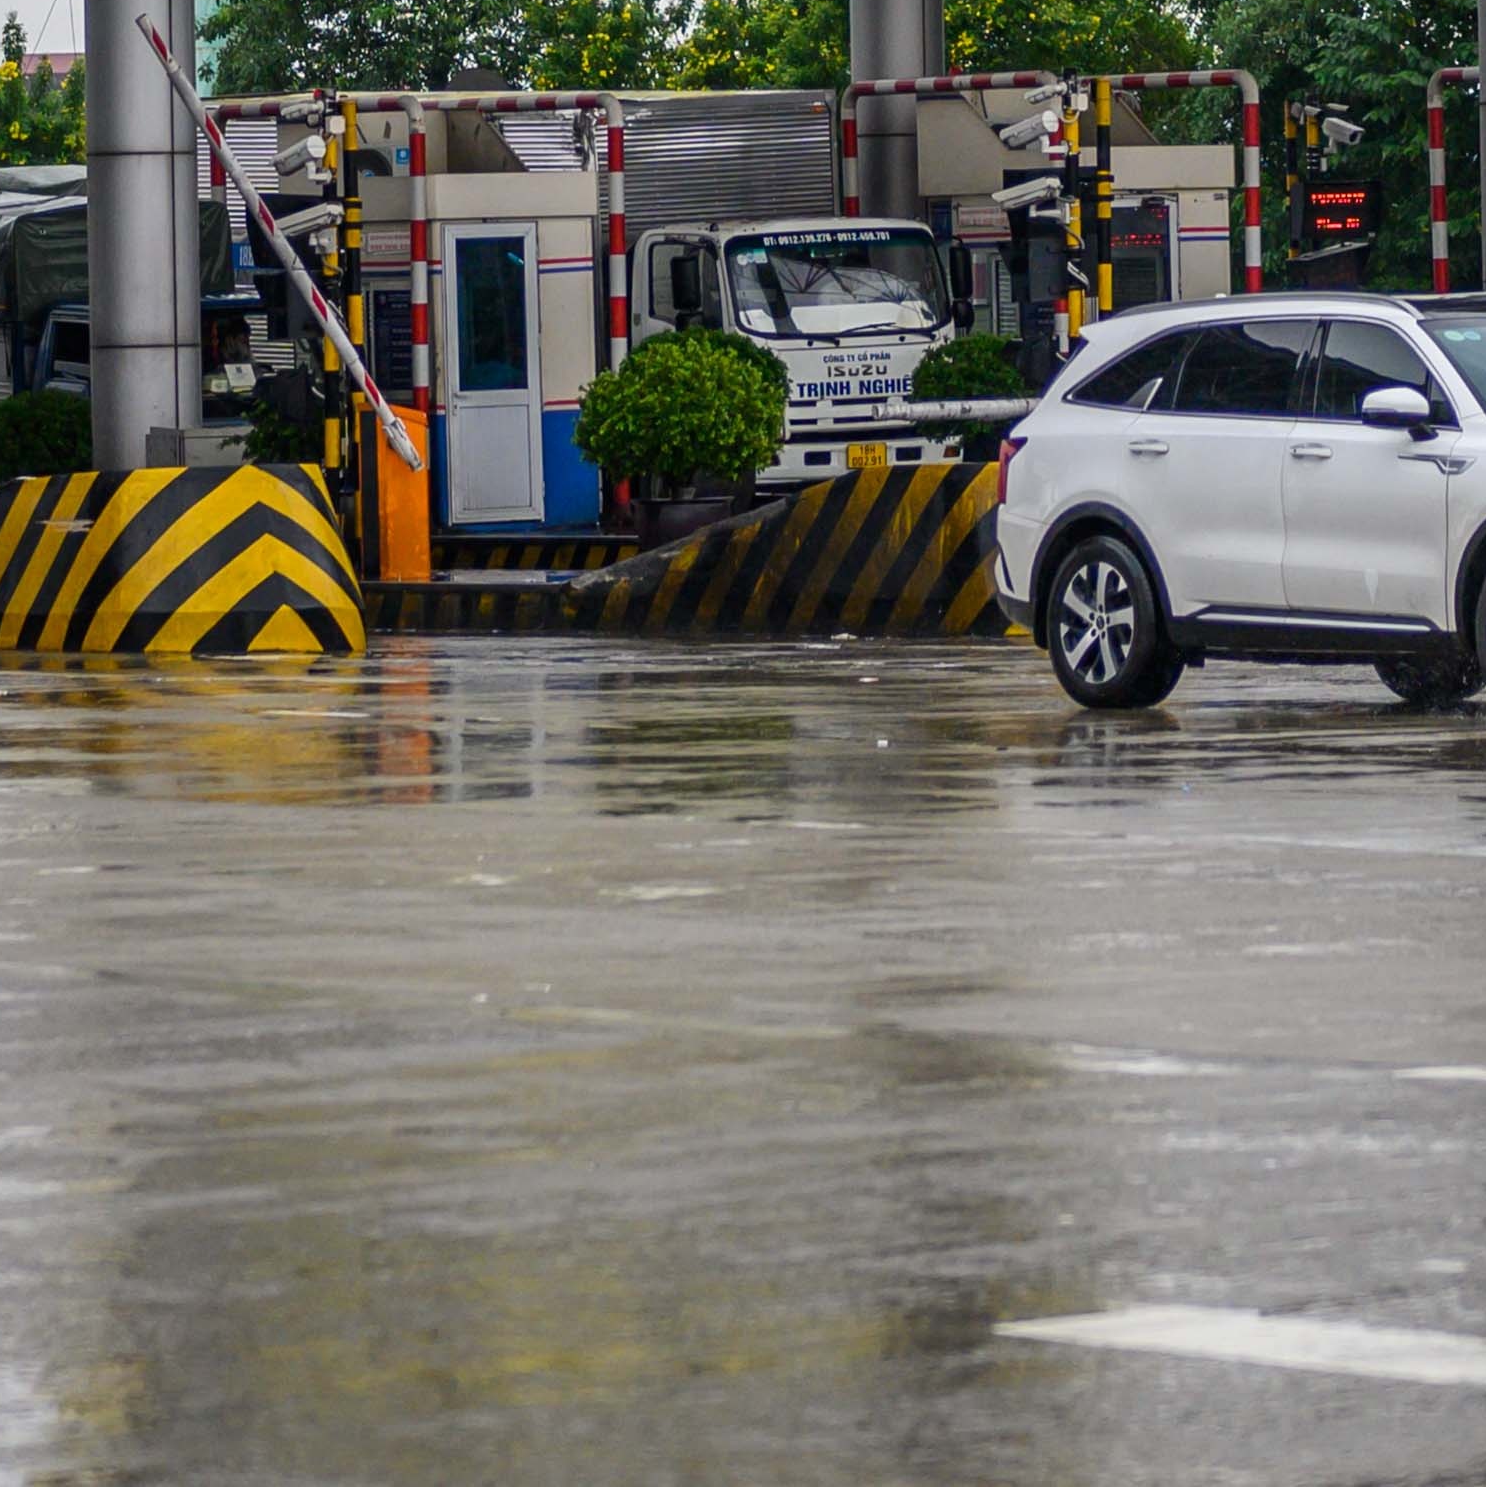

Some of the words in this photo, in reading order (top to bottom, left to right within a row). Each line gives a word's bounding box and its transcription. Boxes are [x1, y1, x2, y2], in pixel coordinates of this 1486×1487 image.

[823, 354, 844, 364] CÔNG
[847, 354, 855, 362] TY
[870, 350, 891, 361] PHẦN
[827, 364, 888, 377] ISUZU
[796, 380, 851, 401] TRỊNH
[859, 374, 913, 395] NGHIÊ
